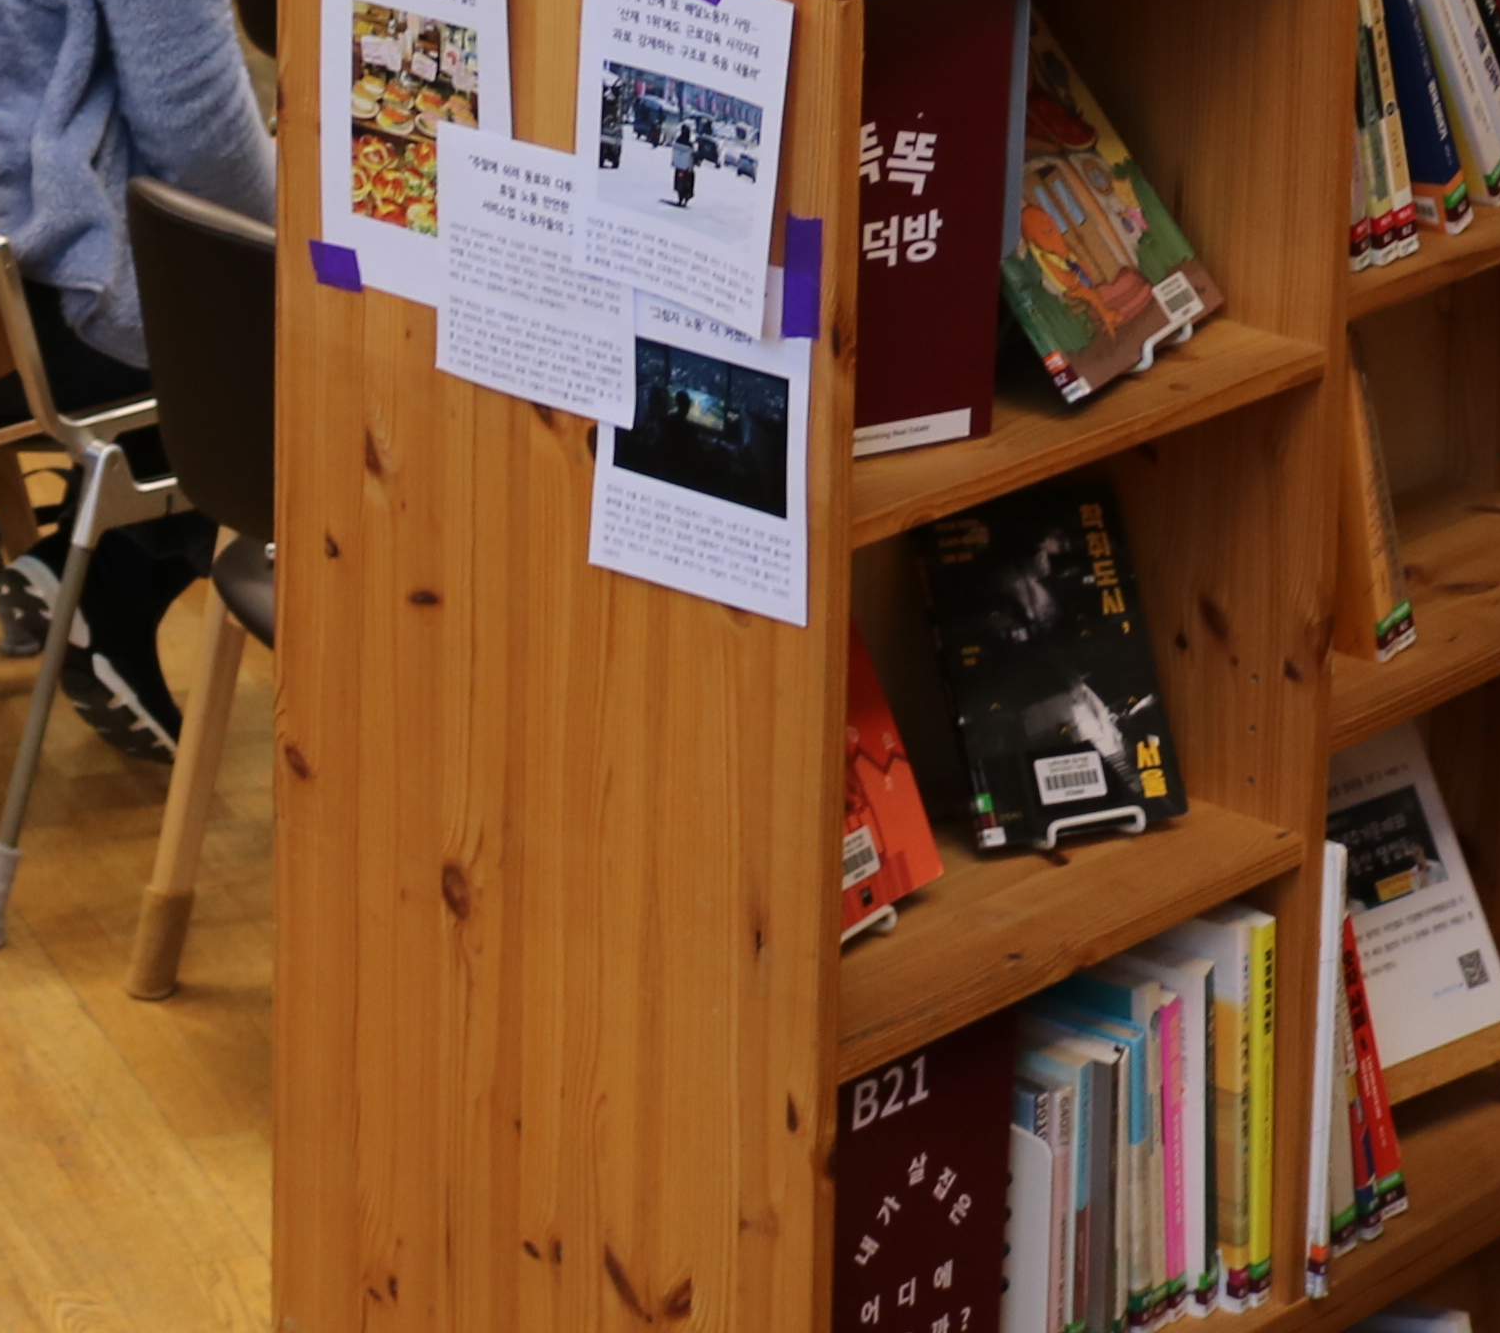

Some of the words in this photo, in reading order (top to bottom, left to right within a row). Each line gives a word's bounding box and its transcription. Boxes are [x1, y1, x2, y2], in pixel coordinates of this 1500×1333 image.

[851, 1054, 931, 1133] B21
[854, 1194, 902, 1267] 내가
[932, 1165, 973, 1227] 집은
[860, 1258, 955, 1325] 어디에
